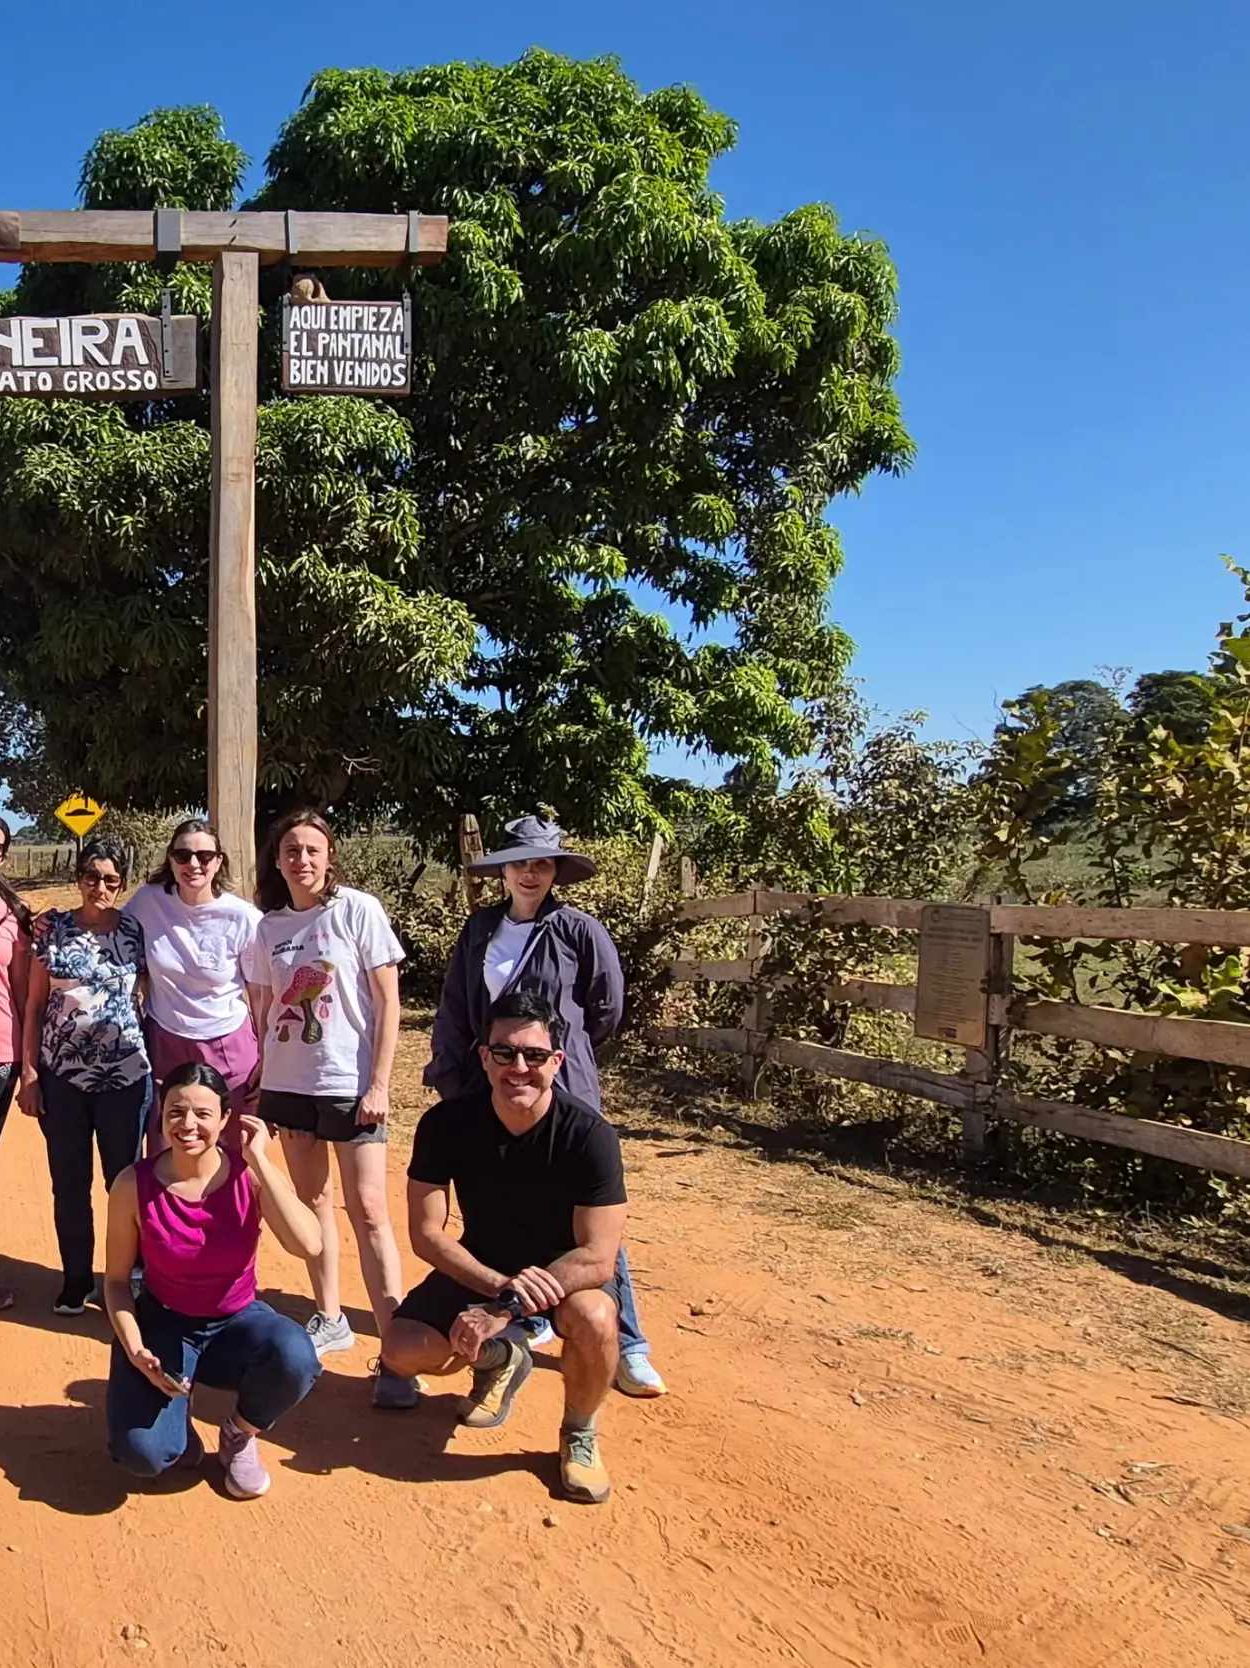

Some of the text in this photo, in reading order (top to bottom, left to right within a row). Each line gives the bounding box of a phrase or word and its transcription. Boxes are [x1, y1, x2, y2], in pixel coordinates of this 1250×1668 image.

[290, 306, 404, 332] AQUI EMPIEZA
[290, 331, 406, 359] EL PANTANAL
[63, 370, 157, 391] GROSSO
[290, 359, 406, 386] BIEN VENIDOS
